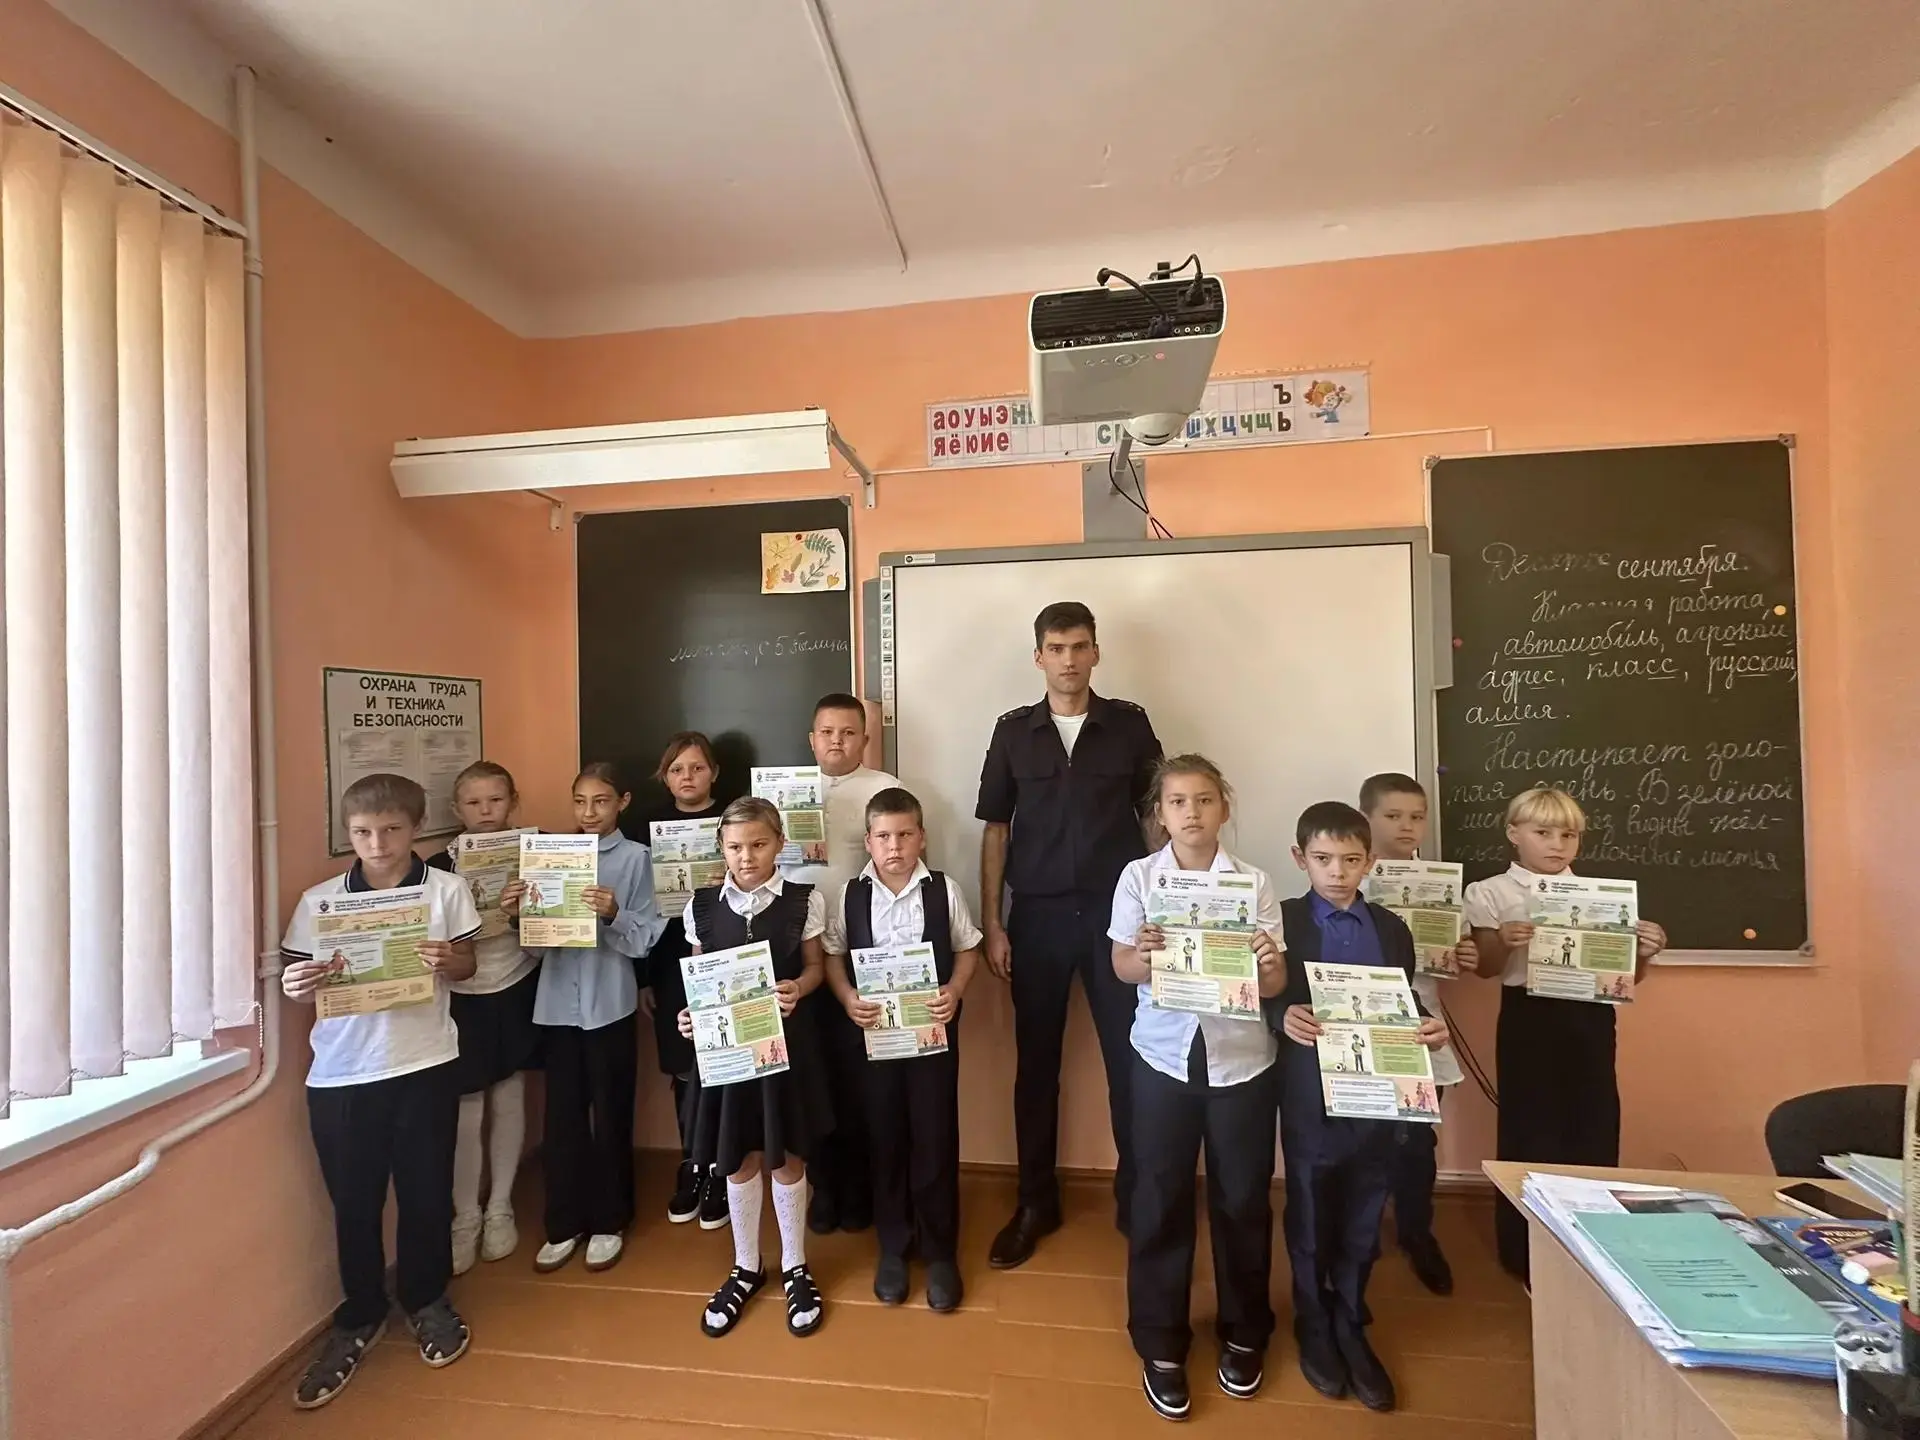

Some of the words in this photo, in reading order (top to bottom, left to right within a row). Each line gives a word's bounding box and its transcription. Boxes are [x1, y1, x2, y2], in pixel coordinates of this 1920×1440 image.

[933, 431, 1009, 457] яёюие
[1482, 542, 1612, 584] Деяте
[1617, 544, 1750, 587] сентября.
[1587, 656, 1688, 683] класс,
[359, 676, 417, 693] ОХРАНА
[428, 681, 467, 698] ТРУДА
[366, 695, 377, 709] И
[386, 696, 446, 711] ТЕХНИКА
[353, 713, 463, 728] БЕЗОПАСНОСТИ
[1484, 731, 1690, 782] Наступает
[1706, 738, 1788, 781] золо-
[1638, 768, 1670, 804] В
[1677, 777, 1794, 821] зелёной
